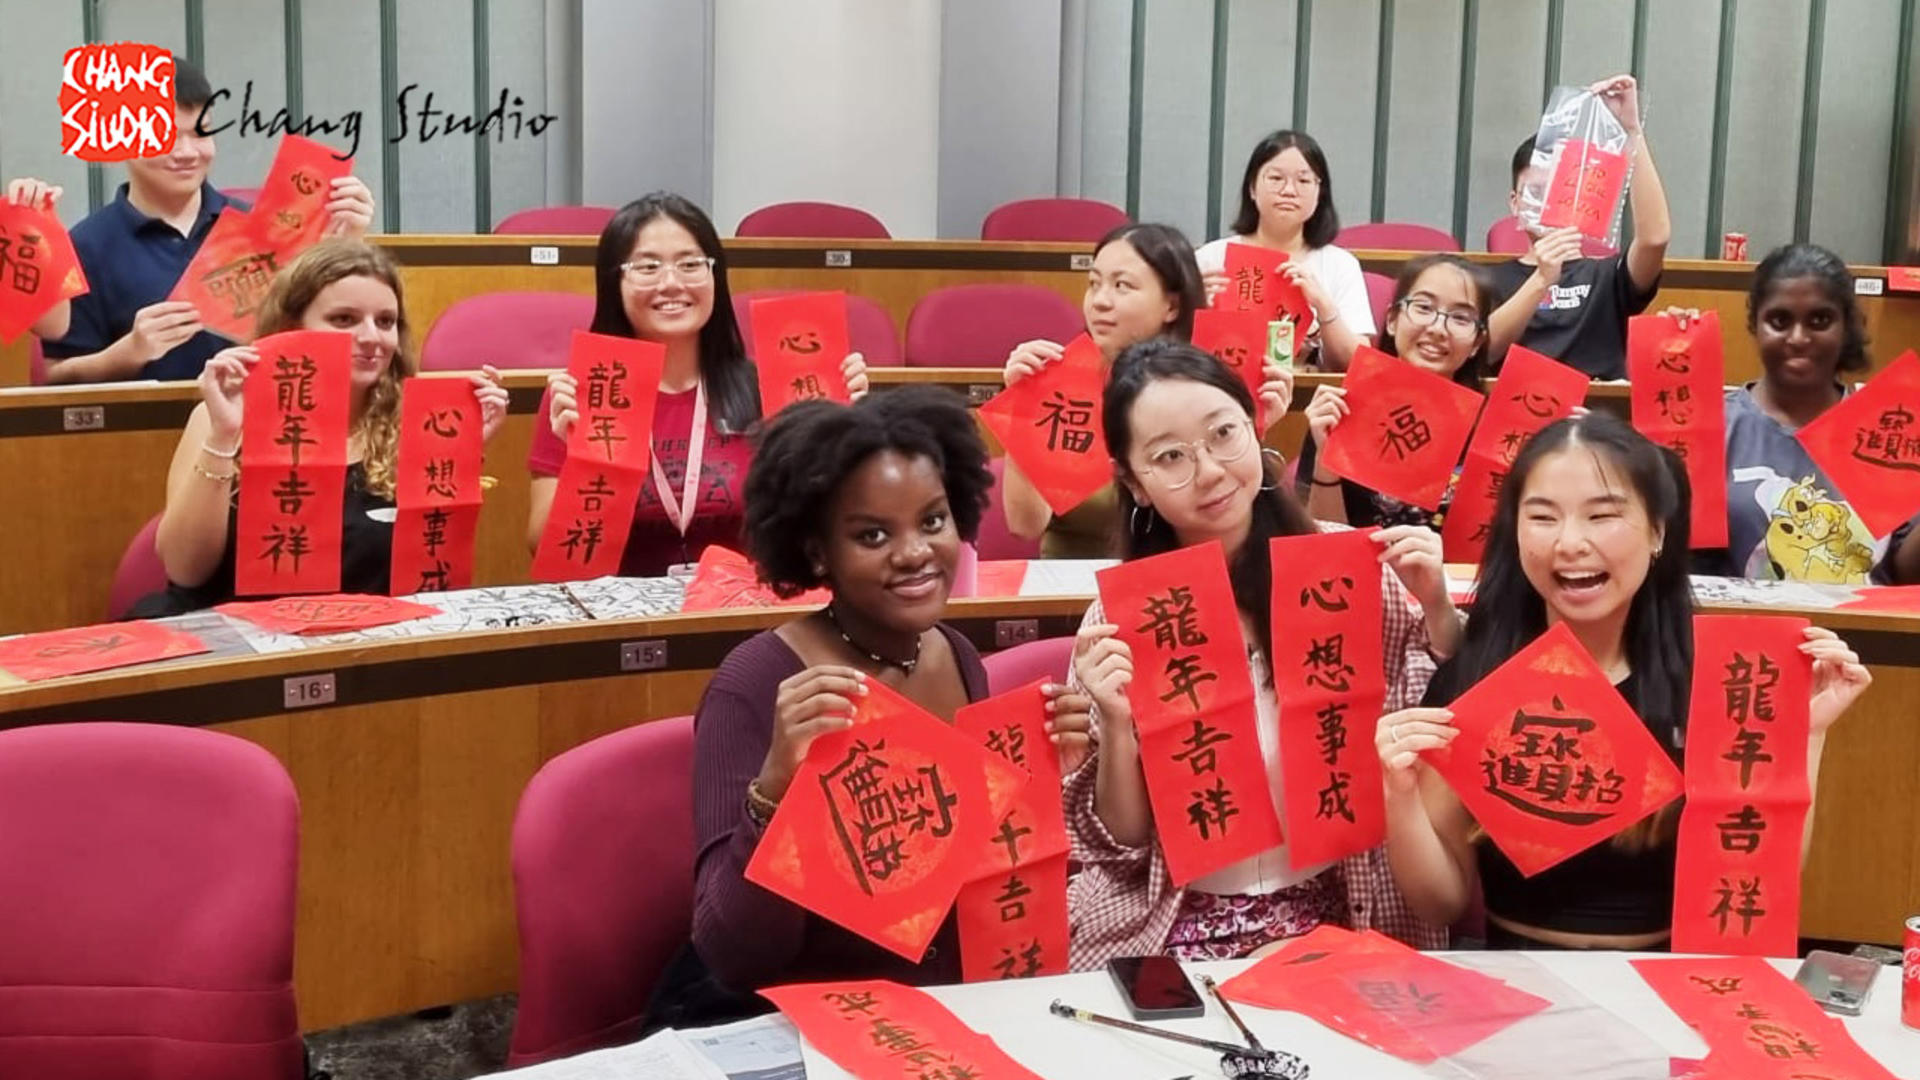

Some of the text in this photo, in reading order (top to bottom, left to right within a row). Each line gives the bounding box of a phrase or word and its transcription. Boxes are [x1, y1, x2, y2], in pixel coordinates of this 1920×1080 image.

[1236, 266, 1264, 311] 龍
[74, 411, 94, 426] 33
[1034, 390, 1095, 453] 福
[1377, 404, 1431, 461] 福
[259, 355, 319, 574] 龍年吉祥
[558, 361, 631, 564] 龍年吉祥
[416, 410, 463, 592] 心想事成
[634, 646, 655, 664] 15
[1008, 625, 1027, 640] 14
[299, 681, 322, 700] 16
[1135, 586, 1241, 841] 龍年吉祥
[1300, 577, 1356, 824] 心想事成
[1708, 652, 1781, 938] 龍年吉祥
